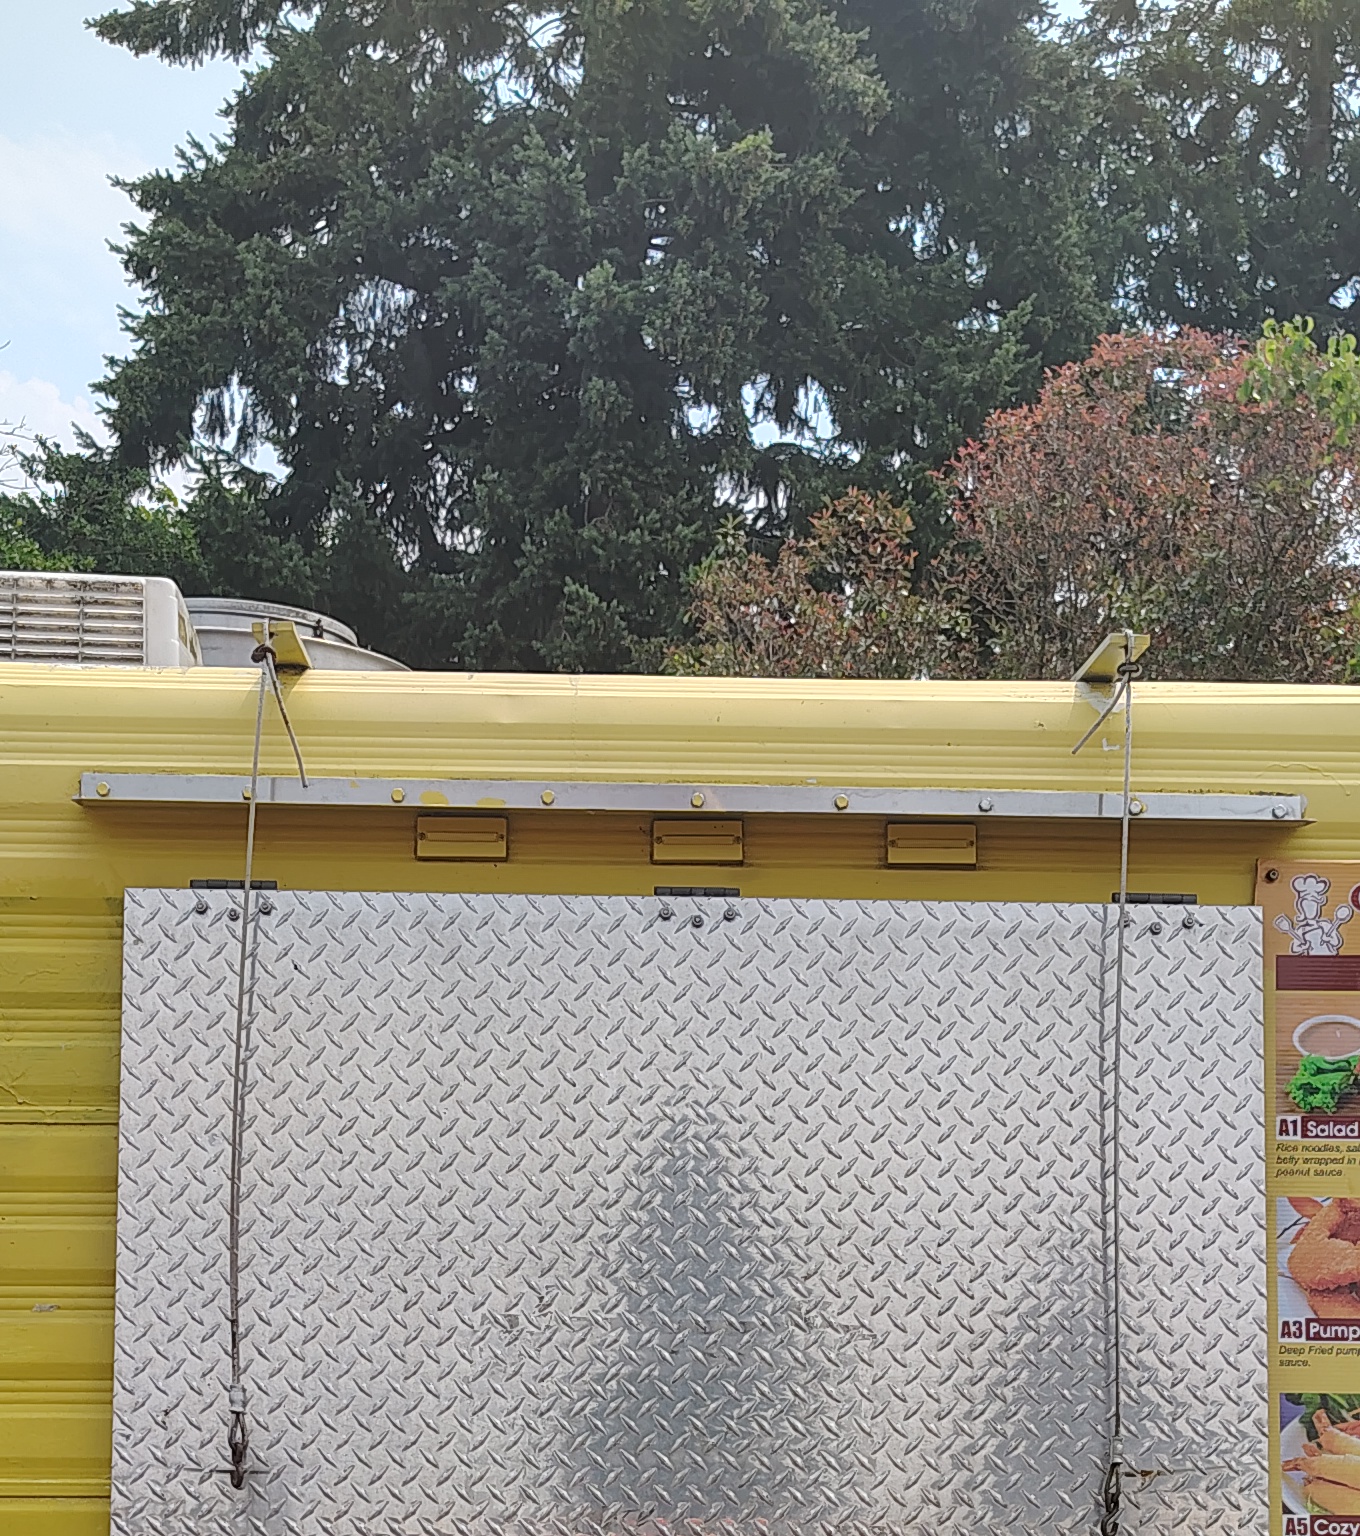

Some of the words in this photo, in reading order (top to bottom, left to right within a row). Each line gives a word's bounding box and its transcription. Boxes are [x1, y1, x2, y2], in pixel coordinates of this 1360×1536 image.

[1278, 1119, 1298, 1137] A1
[1307, 1122, 1358, 1137] Salad
[1281, 1321, 1302, 1338] A3
[1279, 1346, 1305, 1356] Deep
[1308, 1346, 1333, 1355] Fried
[1285, 1518, 1308, 1535] A5
